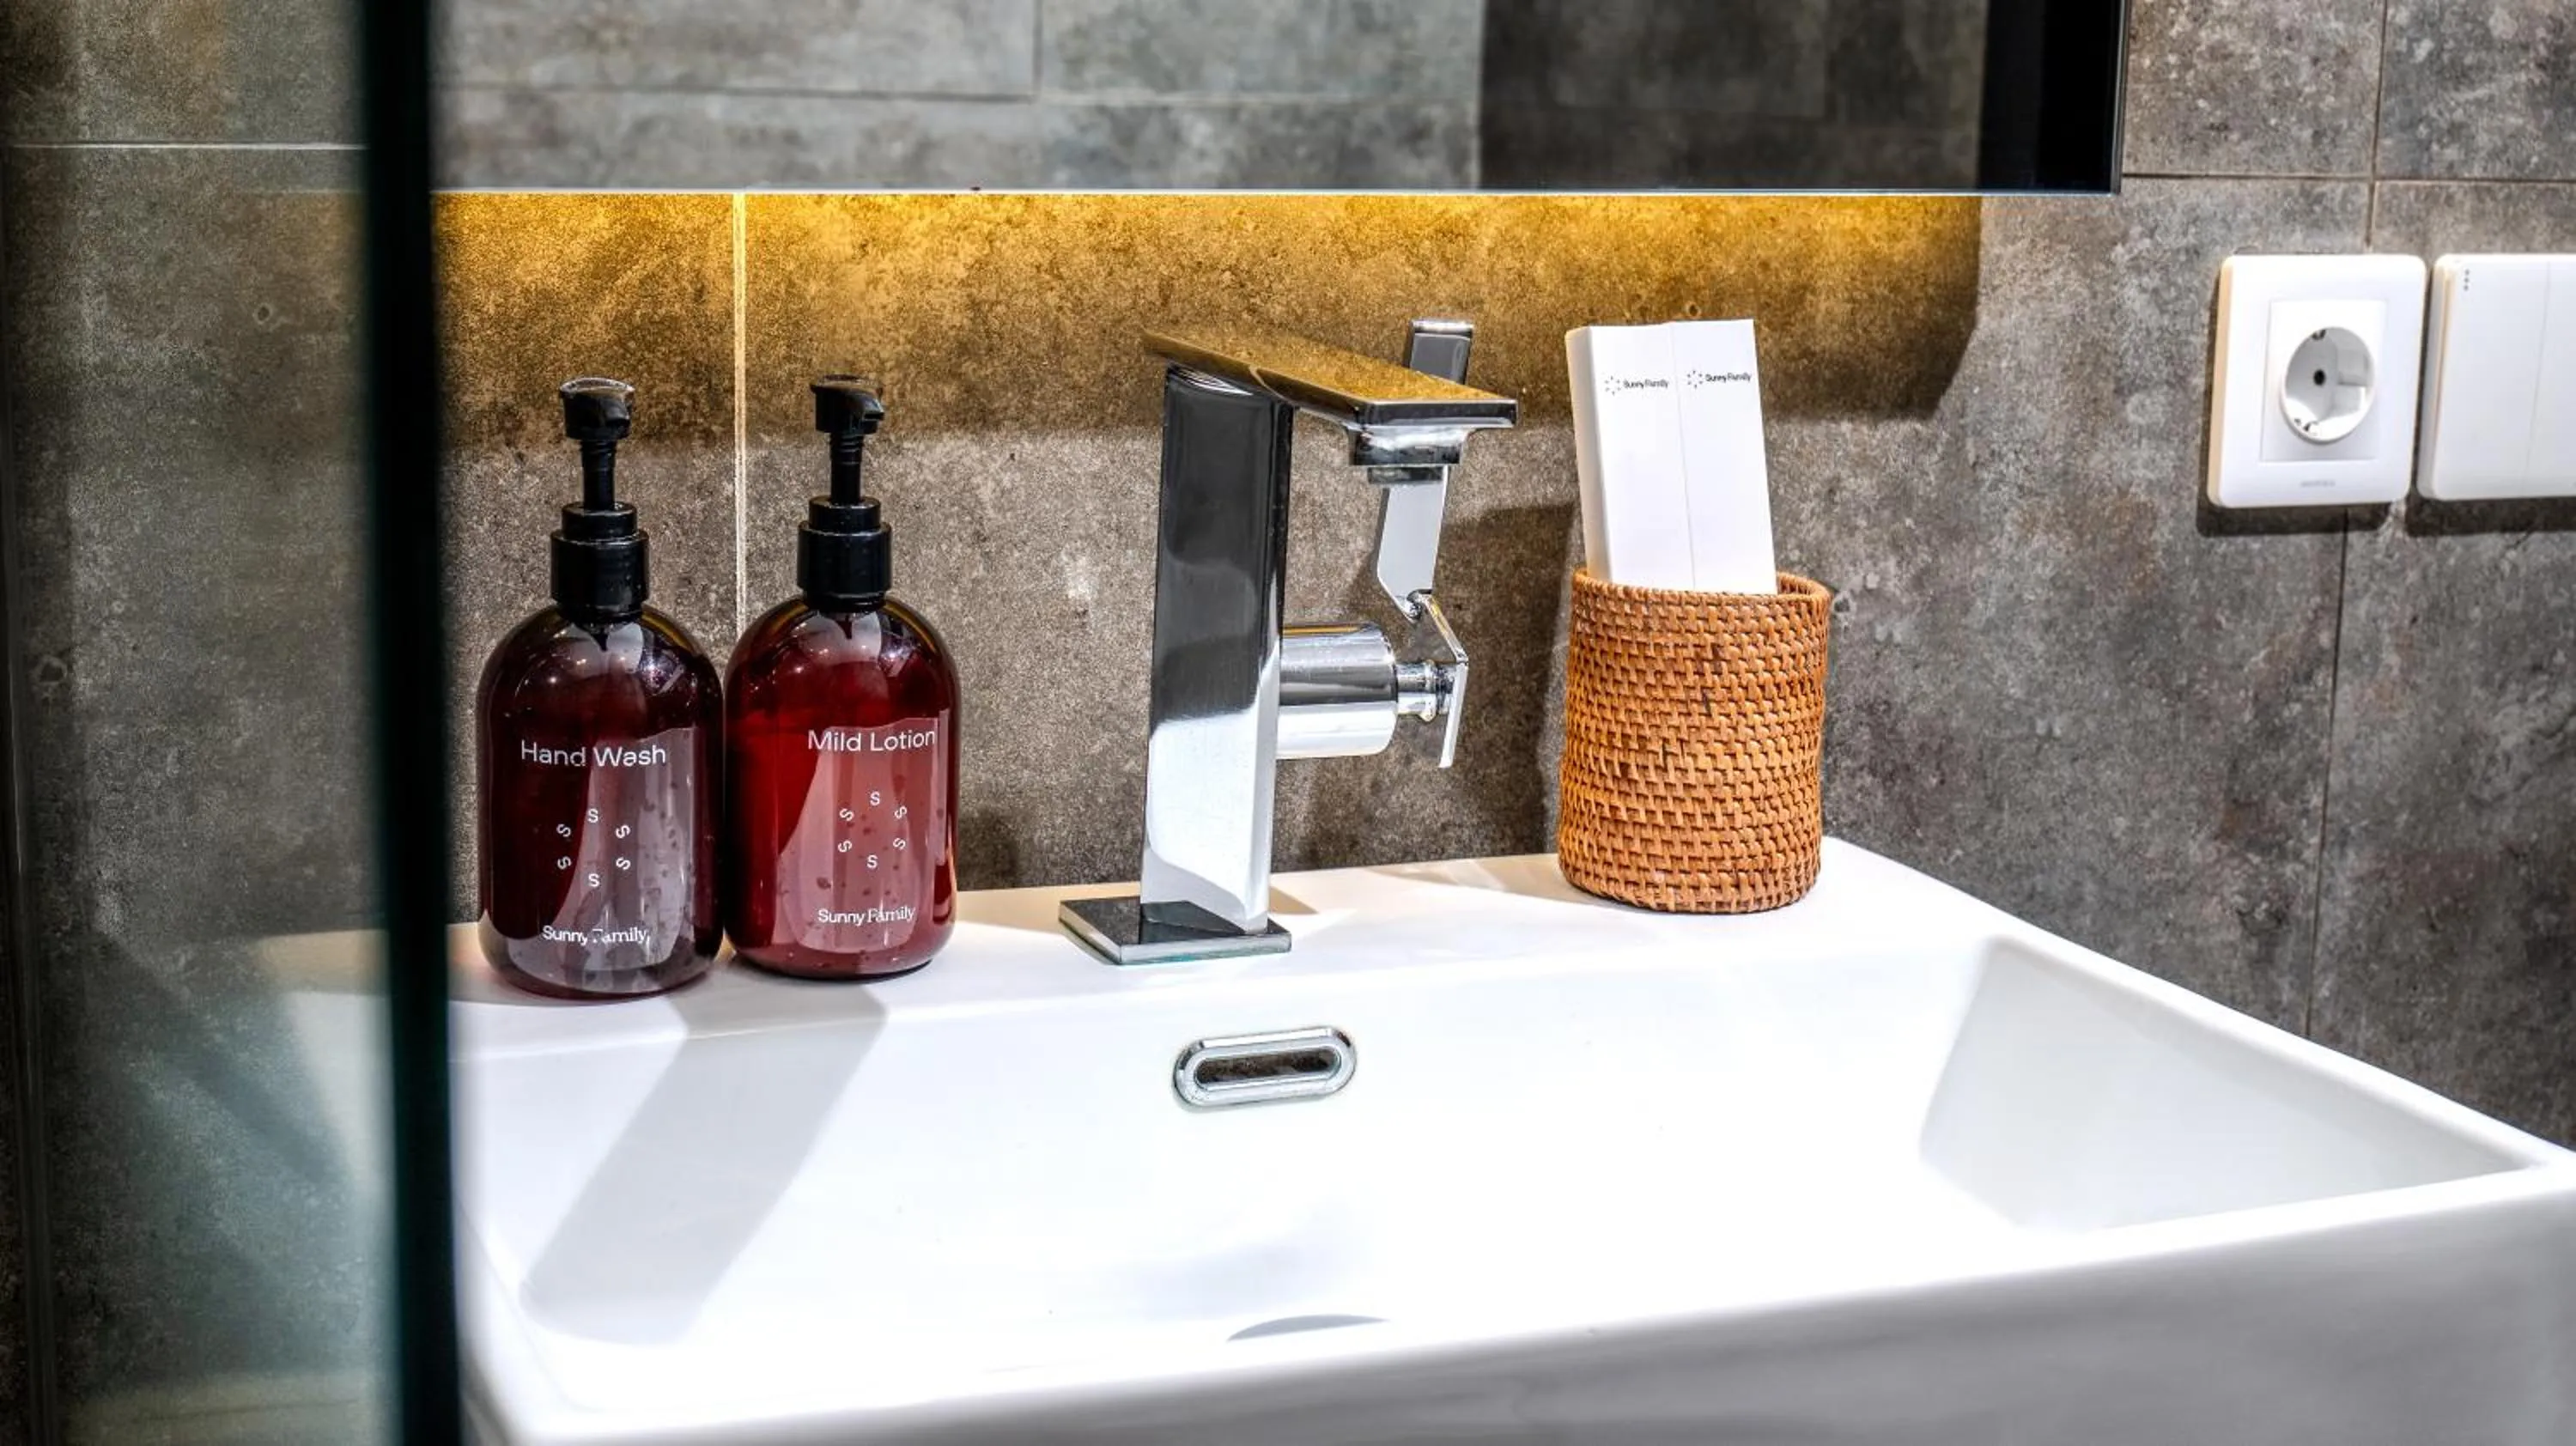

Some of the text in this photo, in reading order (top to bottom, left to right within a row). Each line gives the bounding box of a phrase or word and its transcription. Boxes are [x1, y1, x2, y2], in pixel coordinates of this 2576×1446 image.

[807, 730, 936, 752] Mild Lotion
[520, 739, 666, 767] Hand Wash
[817, 905, 916, 927] Sunny Family
[542, 925, 588, 946] Sunny
